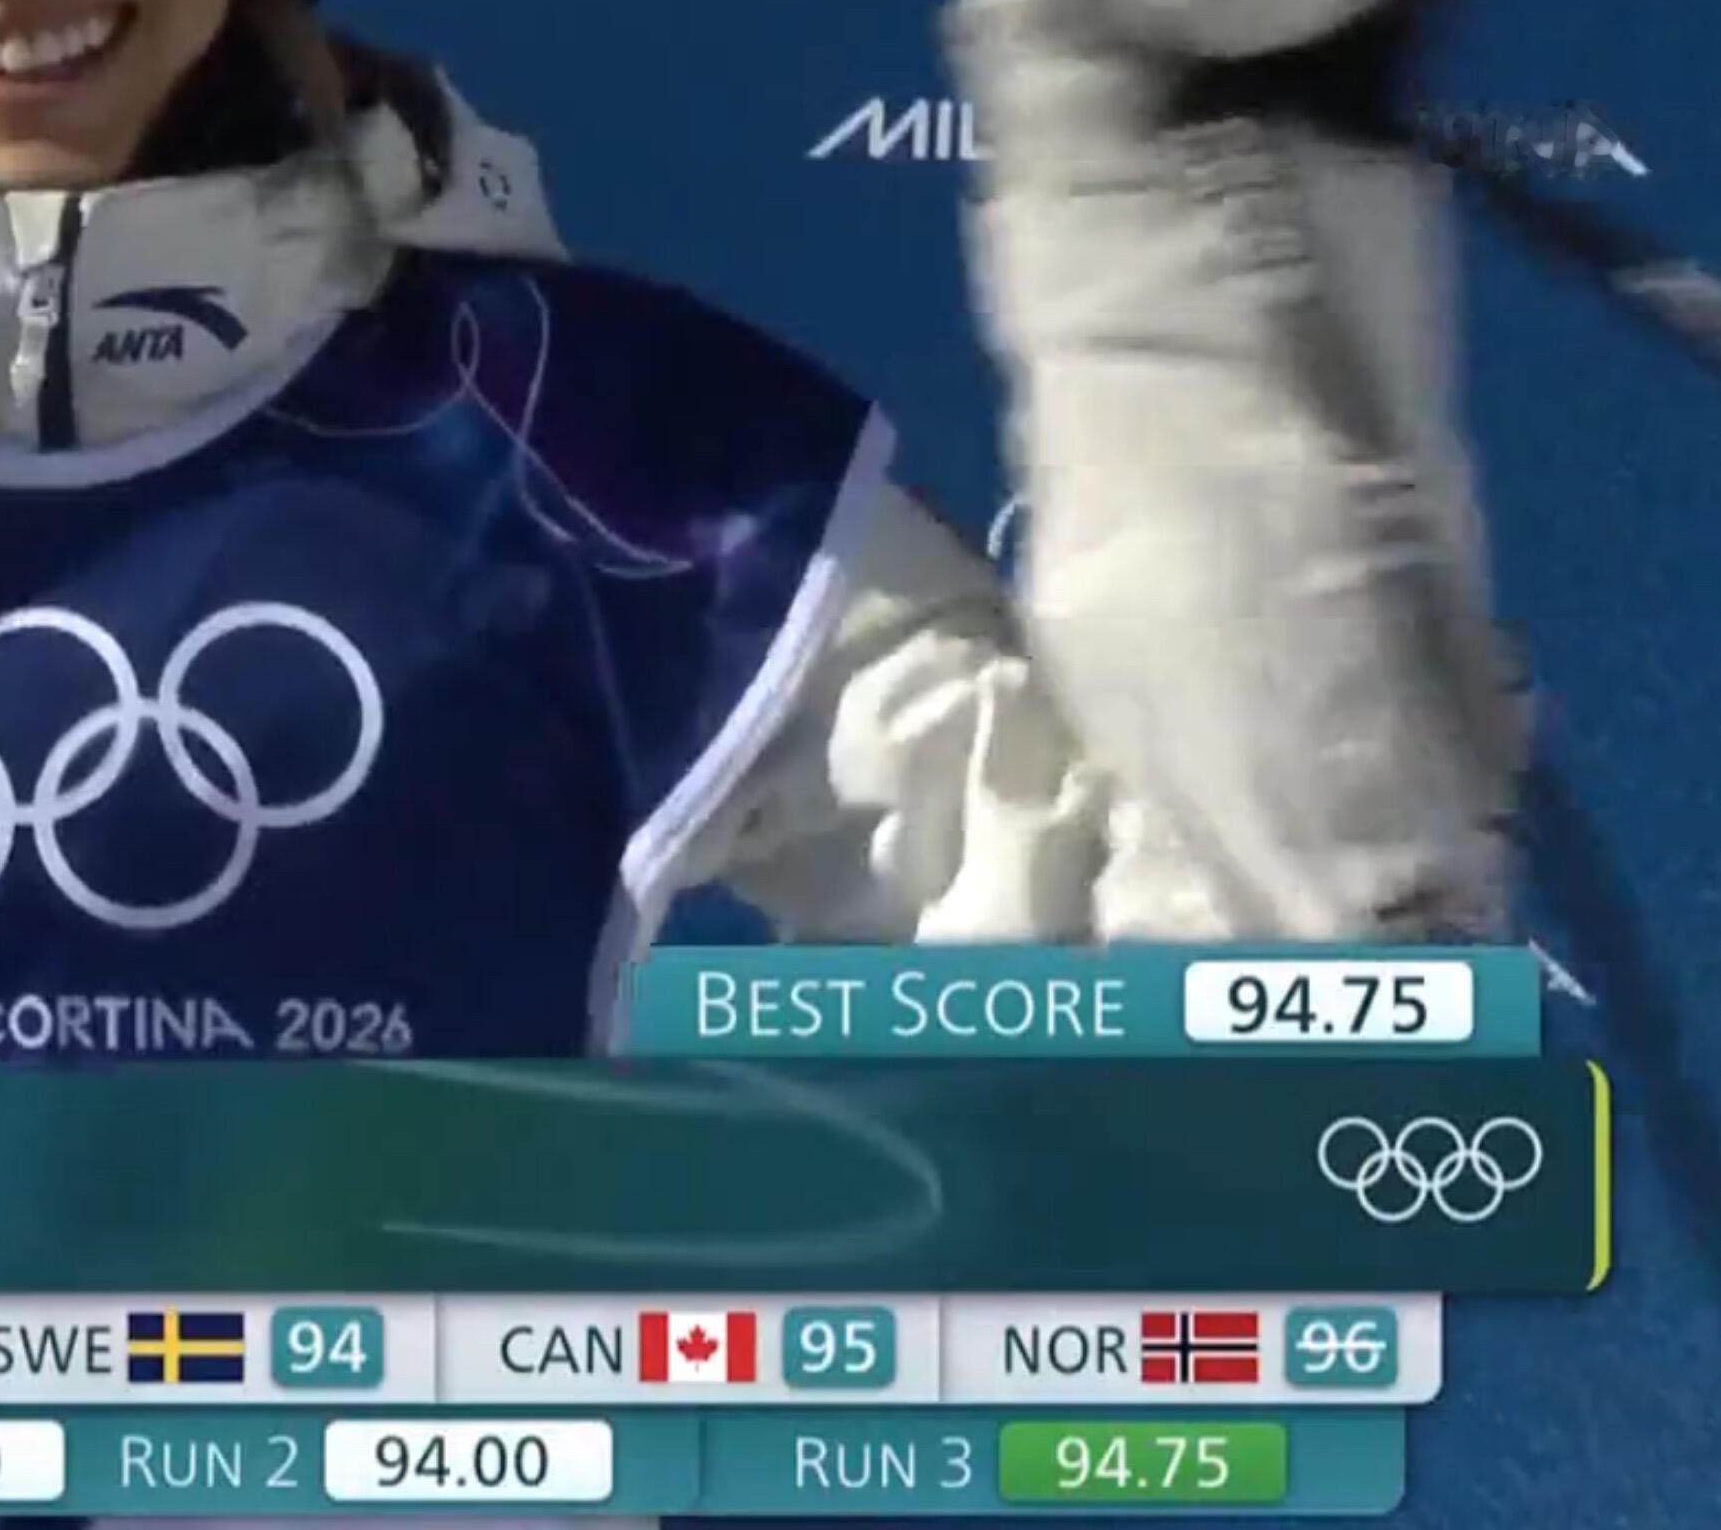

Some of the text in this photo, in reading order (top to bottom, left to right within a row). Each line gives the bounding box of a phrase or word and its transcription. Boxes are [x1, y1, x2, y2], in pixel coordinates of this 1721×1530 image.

[806, 97, 997, 160] MIL
[92, 324, 183, 365] ANTA
[277, 997, 414, 1053] 2026
